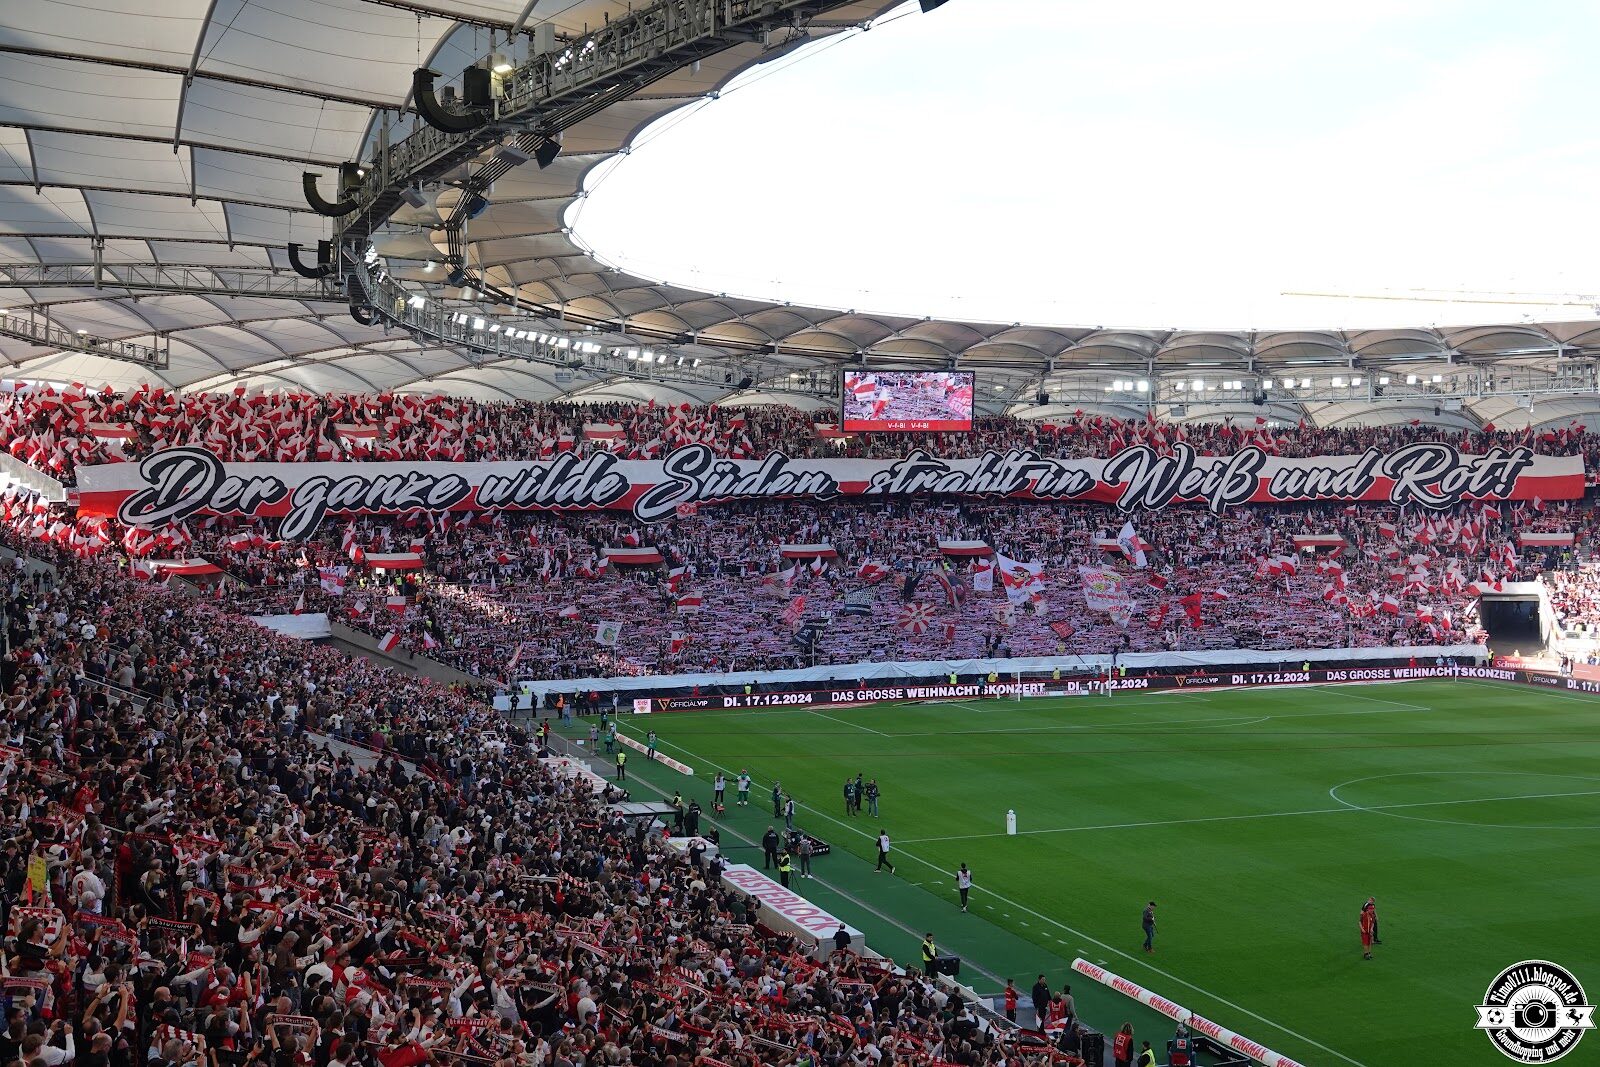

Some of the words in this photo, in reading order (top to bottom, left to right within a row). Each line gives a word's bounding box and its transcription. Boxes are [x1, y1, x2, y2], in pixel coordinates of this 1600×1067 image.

[117, 446, 288, 529] Der
[277, 470, 472, 541] ganze
[474, 449, 631, 509] wilde
[632, 443, 843, 524] Süden
[863, 448, 1040, 498] strahlt
[1030, 455, 1097, 498] in
[1101, 442, 1267, 517] Weiß
[1267, 445, 1383, 500] und
[1382, 442, 1534, 510] Rot!
[1232, 674, 1248, 685] DI.
[1251, 672, 1311, 684] 17.12.2024
[1326, 670, 1348, 681] DAS
[1350, 668, 1391, 680] GROSSE
[1393, 666, 1516, 681] WEIHNACHTSKONZERT
[1067, 681, 1082, 691] DI.
[1087, 678, 1148, 690] 1712.2024
[1567, 678, 1580, 690] DI.
[723, 696, 741, 708] DI.
[745, 693, 813, 706] 17.12.2024
[831, 691, 854, 702] DAS
[856, 688, 903, 700] GROSSE
[1076, 960, 1106, 981] WINAMAX
[1111, 976, 1143, 999] WINAMAX
[1149, 994, 1182, 1018] WINAMAX
[1231, 1034, 1269, 1061] WINAMAX
